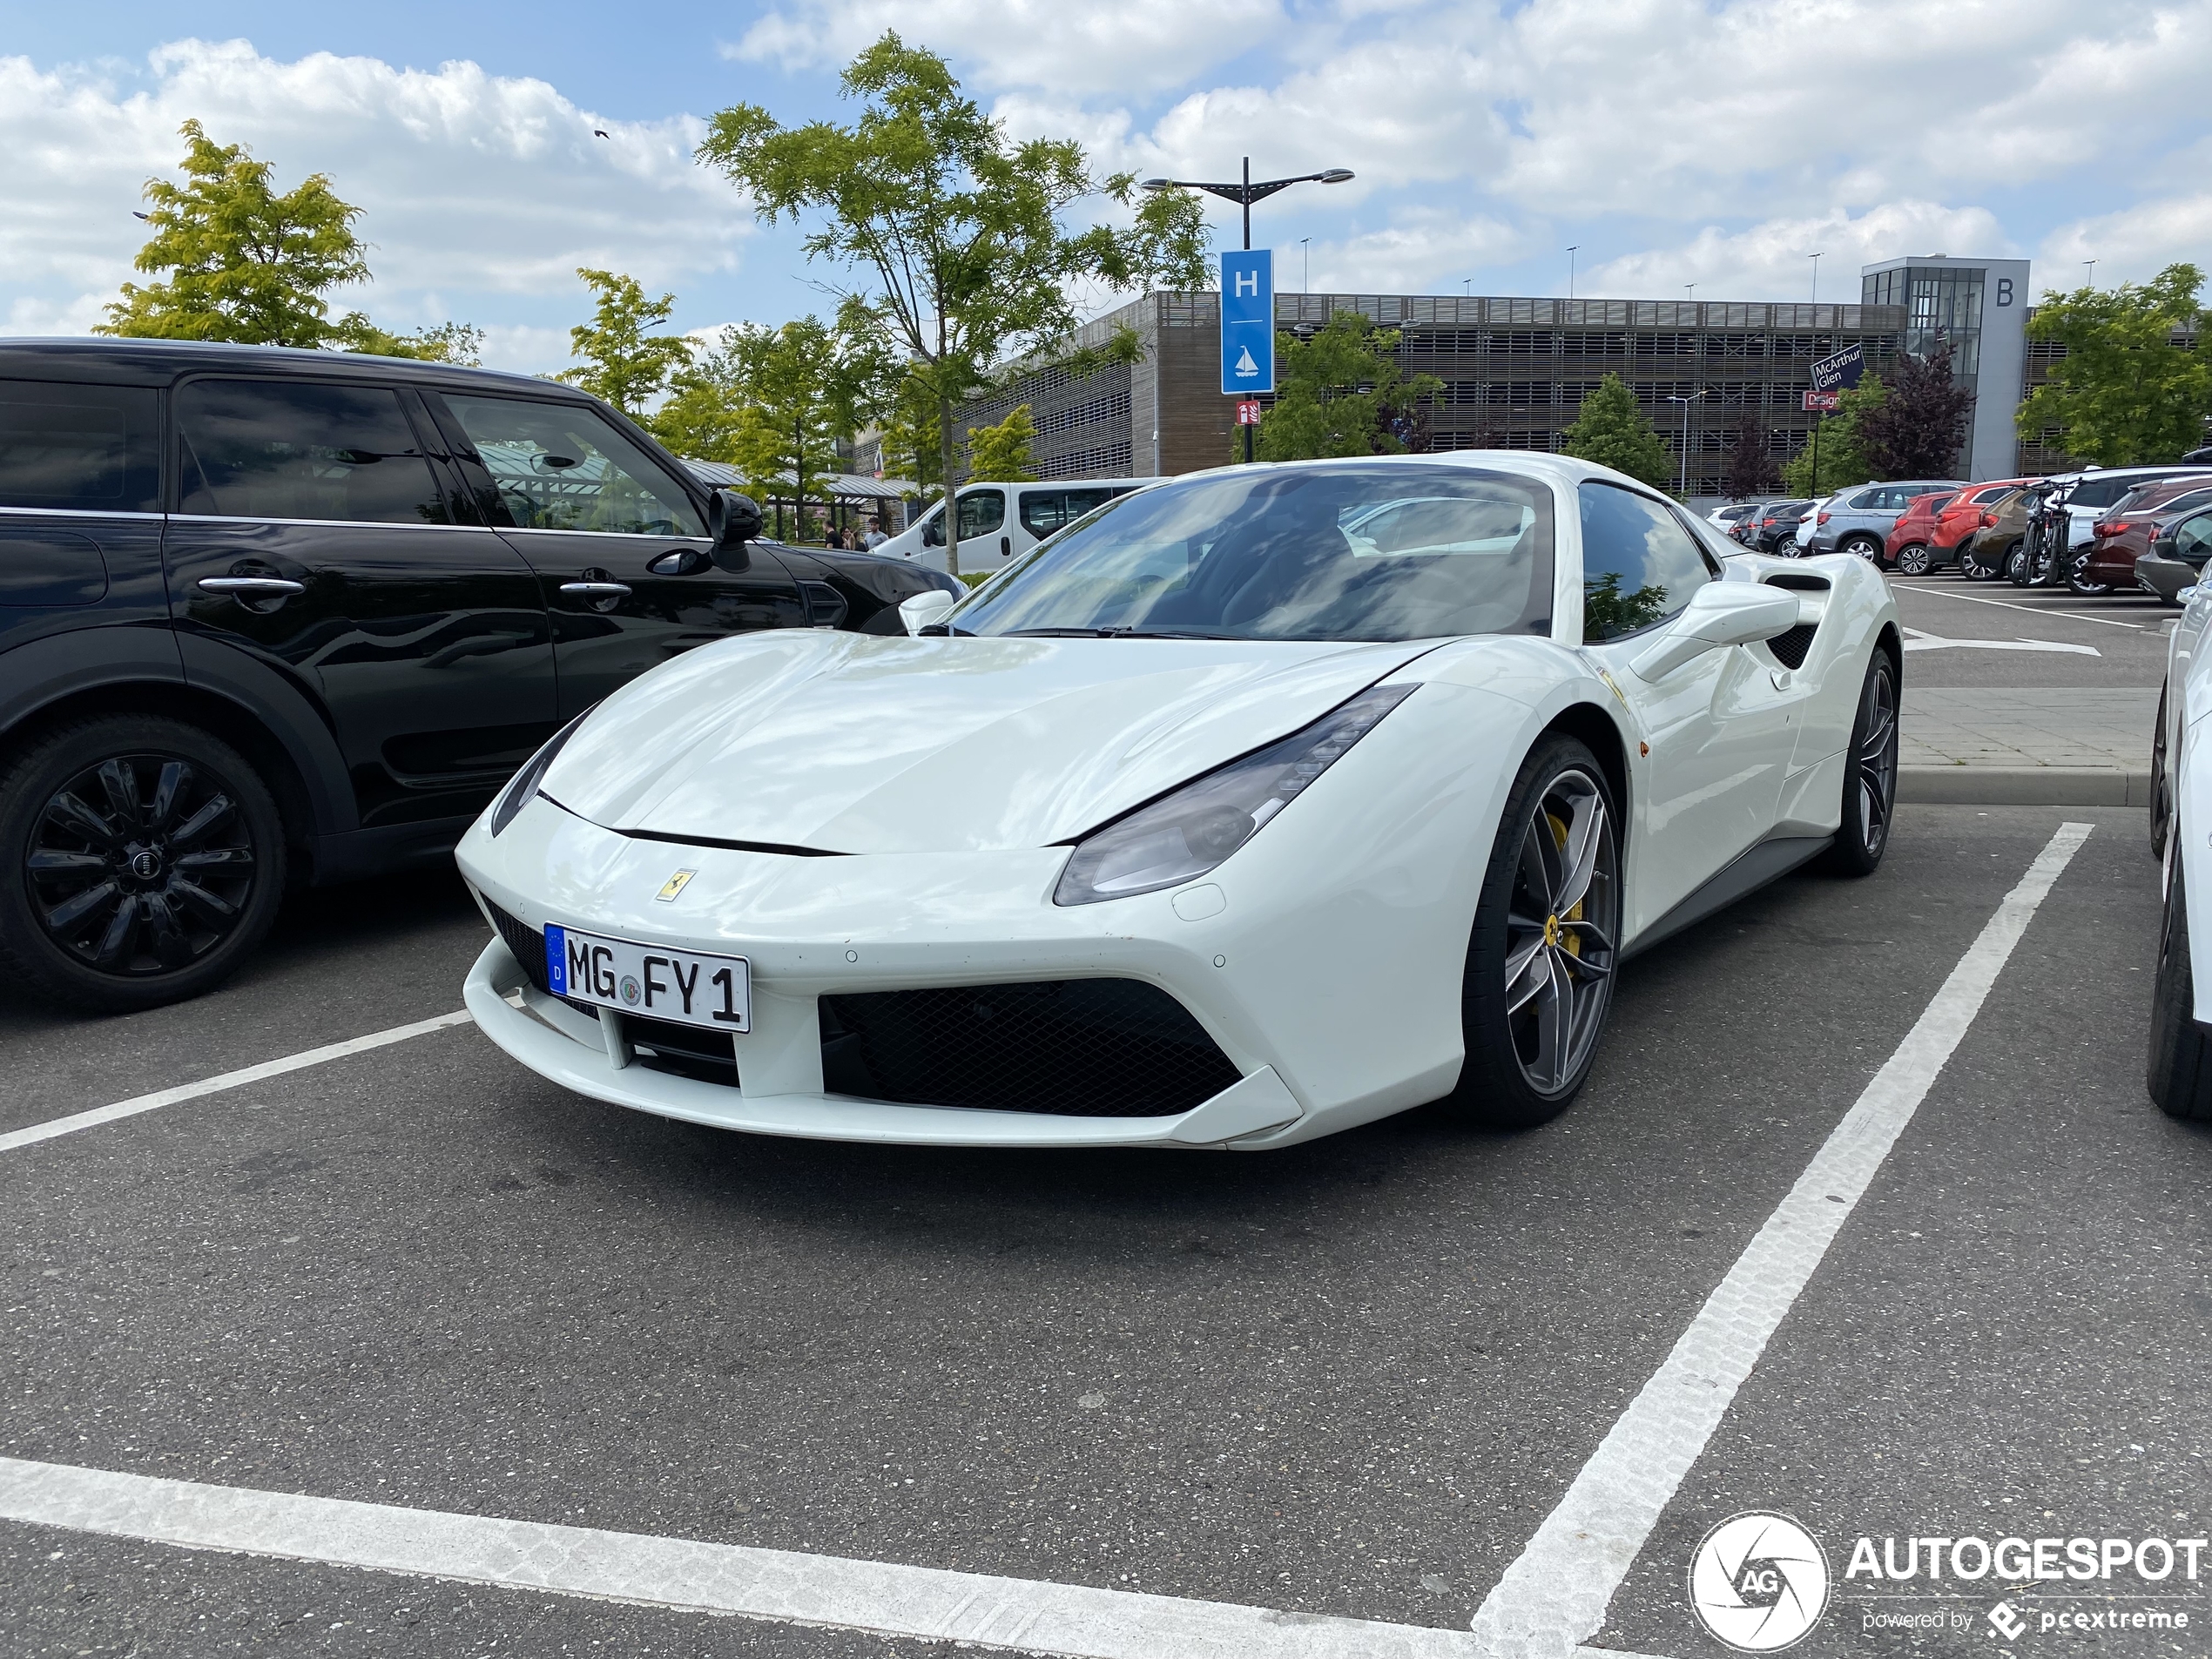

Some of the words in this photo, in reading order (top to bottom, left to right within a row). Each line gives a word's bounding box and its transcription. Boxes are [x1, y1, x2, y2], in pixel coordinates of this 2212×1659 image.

[1235, 270, 1258, 298] H
[1996, 278, 2013, 307] B
[1815, 349, 1861, 378] McArthur
[1818, 372, 1842, 388] Glen
[142, 855, 151, 874] MINI
[554, 966, 562, 981] D
[568, 938, 616, 1000] MG
[643, 954, 699, 1015] FY
[711, 967, 741, 1023] 1
